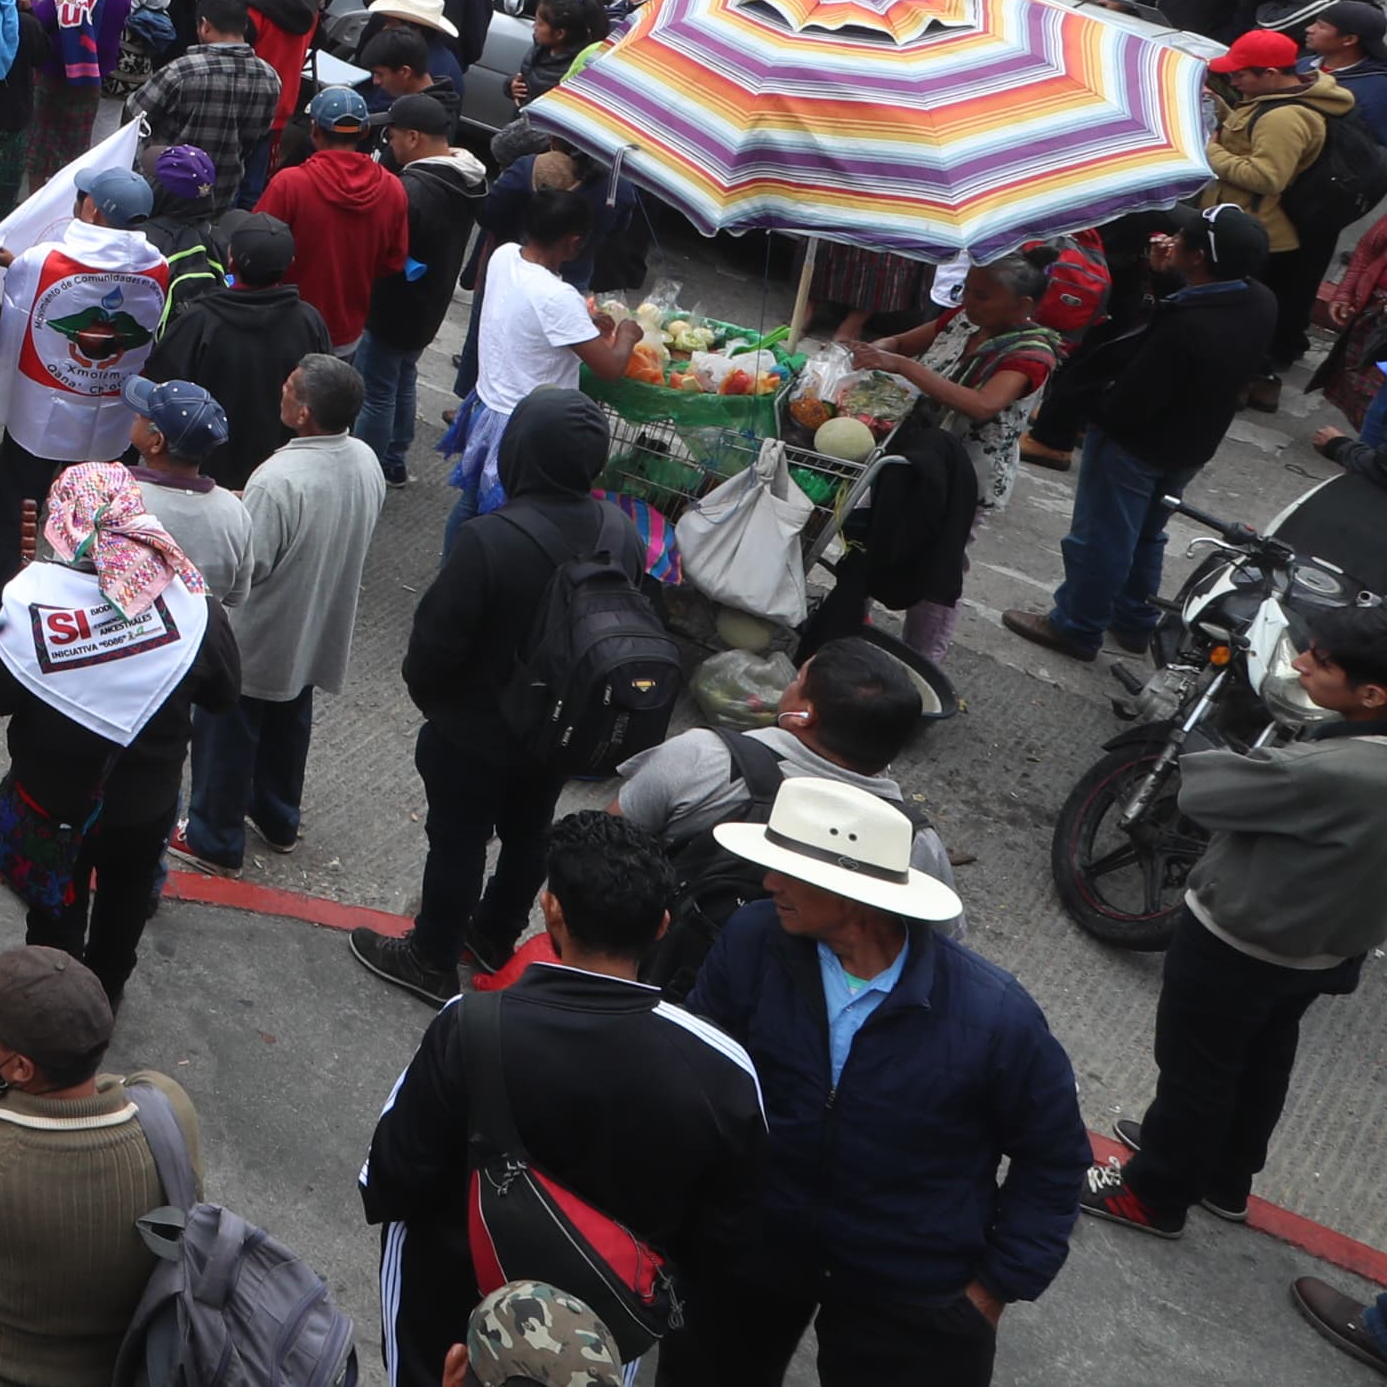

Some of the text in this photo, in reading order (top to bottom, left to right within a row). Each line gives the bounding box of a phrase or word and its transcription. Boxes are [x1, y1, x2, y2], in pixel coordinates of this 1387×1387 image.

[61, 280, 73, 291] de
[73, 273, 141, 285] Comunidades
[46, 608, 92, 646] SI
[50, 643, 99, 660] INICIATIVA
